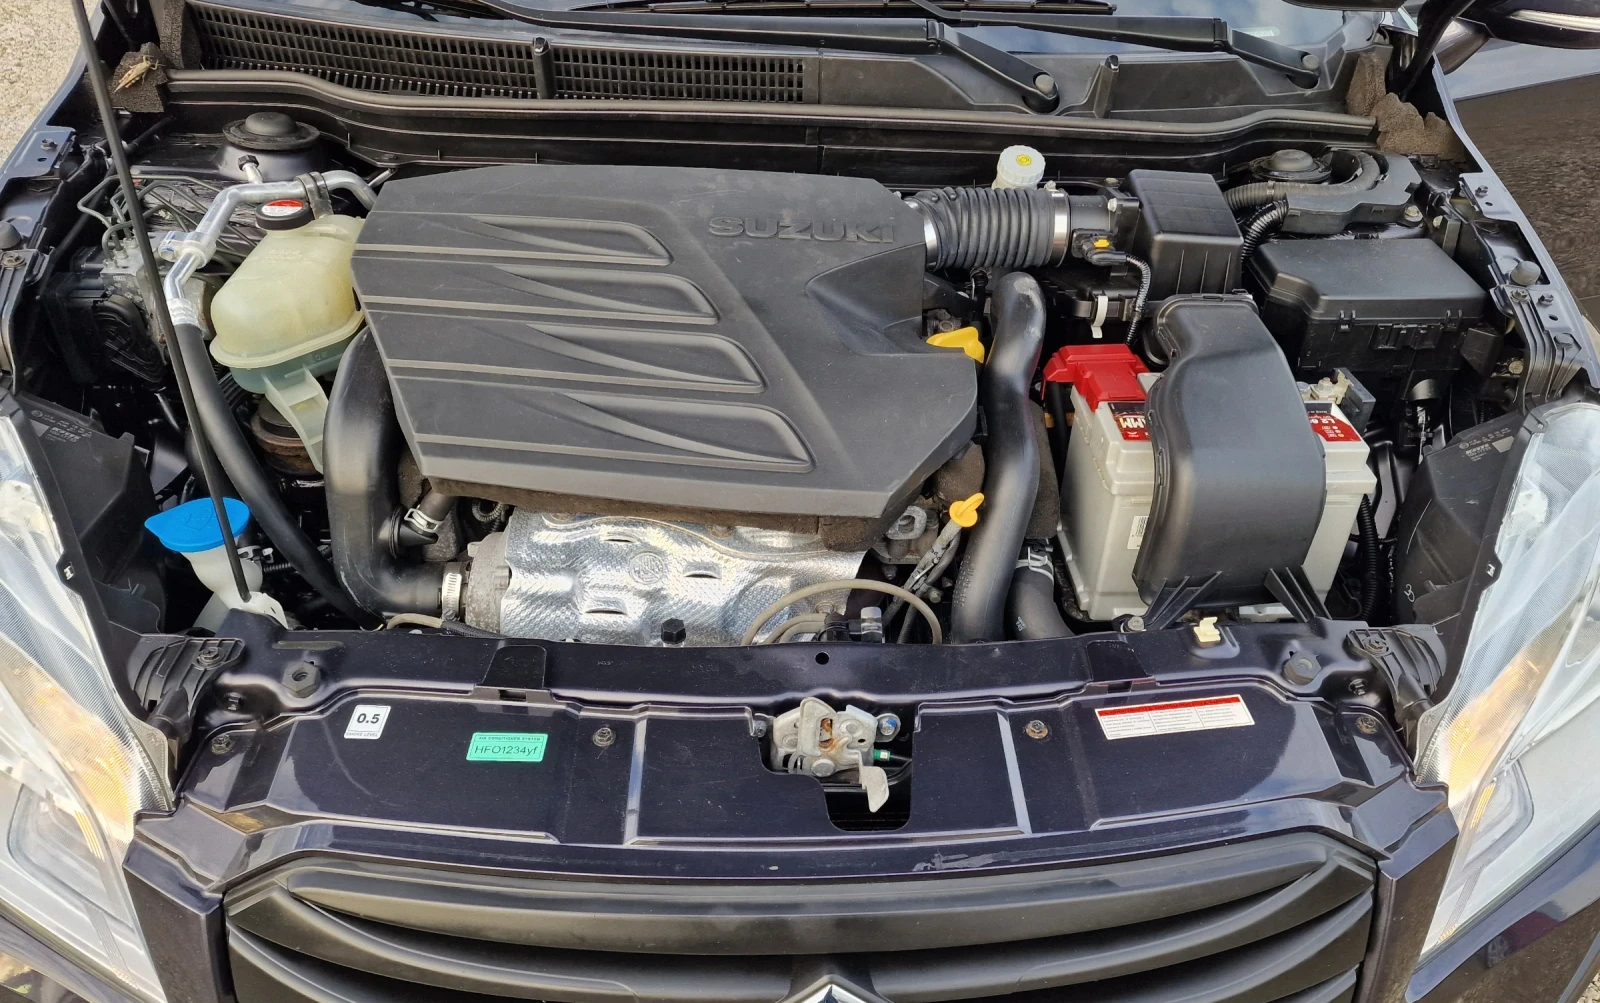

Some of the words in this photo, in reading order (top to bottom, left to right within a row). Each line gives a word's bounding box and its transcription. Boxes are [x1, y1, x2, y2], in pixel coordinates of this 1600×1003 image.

[709, 216, 894, 243] SUZUKI
[357, 713, 381, 724] 0.5
[474, 745, 539, 757] HFO1234yf
